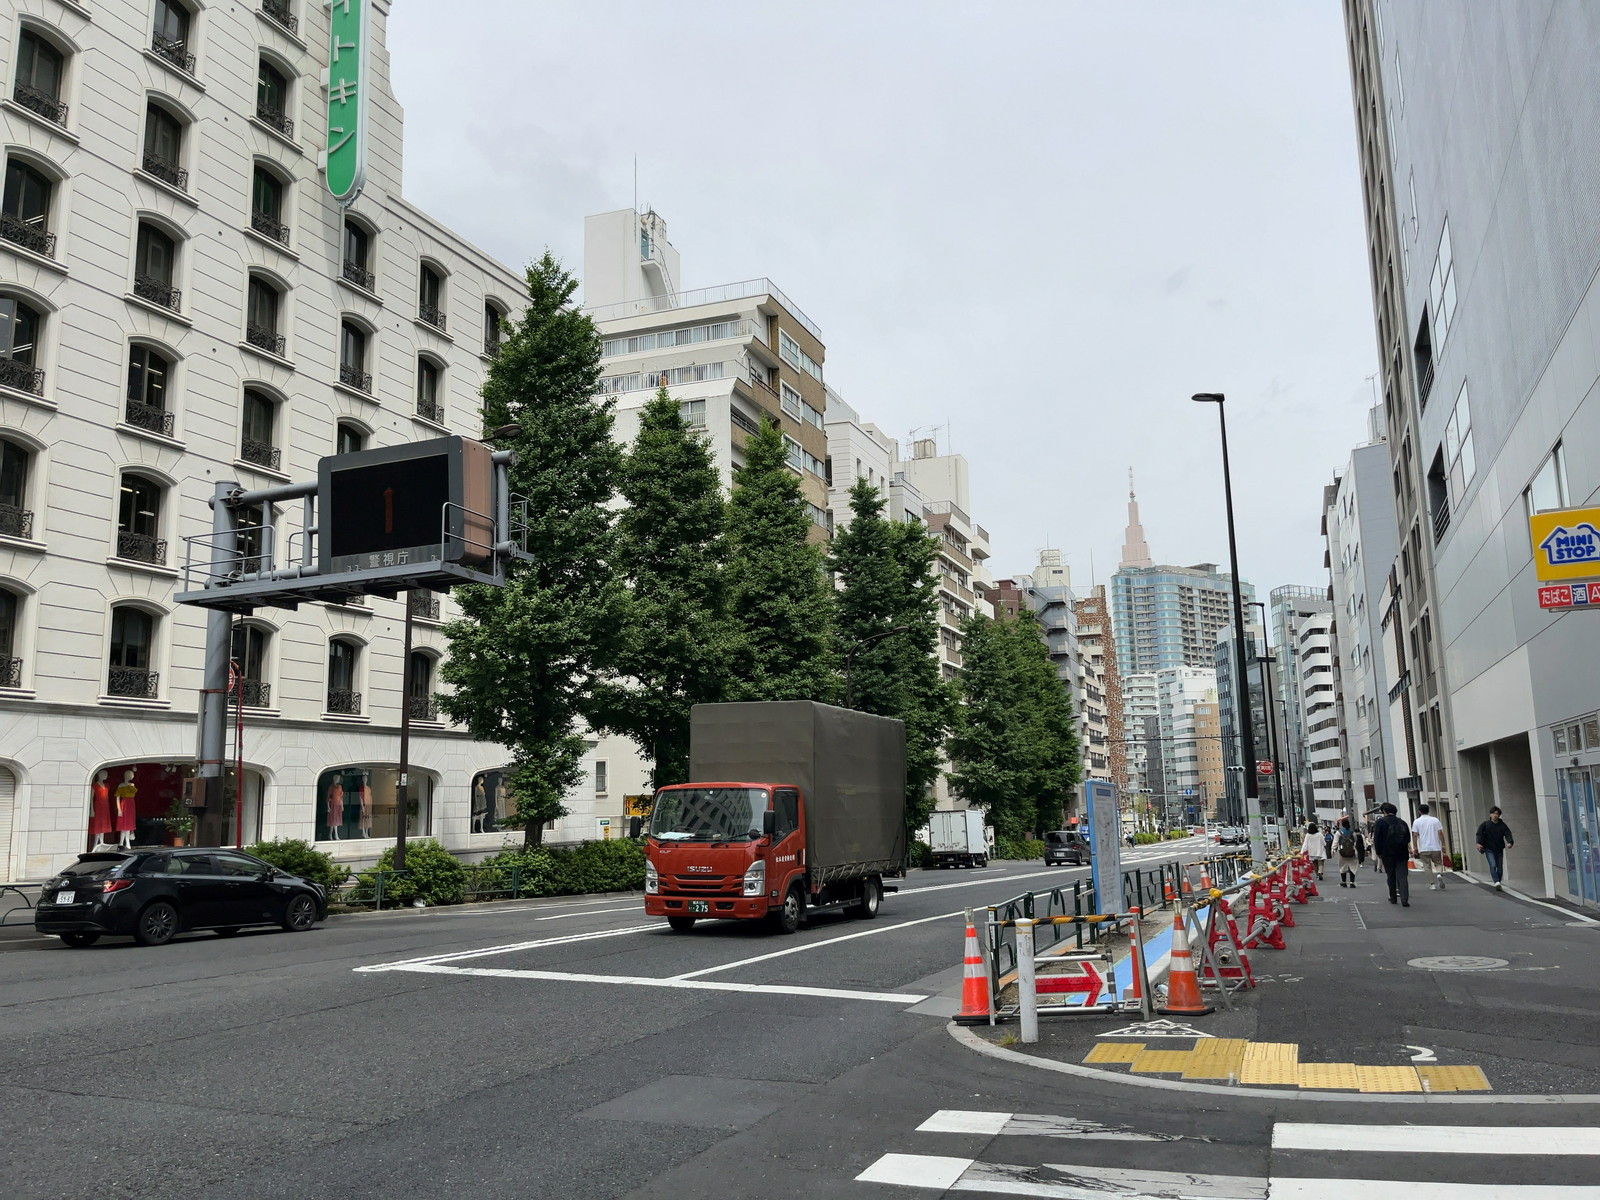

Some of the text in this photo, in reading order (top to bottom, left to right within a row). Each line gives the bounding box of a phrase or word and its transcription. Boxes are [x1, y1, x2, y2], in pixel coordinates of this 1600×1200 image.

[1556, 534, 1593, 547] MINI
[369, 551, 408, 568] 警視庁
[1556, 546, 1596, 560] STOP
[1541, 589, 1570, 604] たばこ
[1573, 587, 1586, 602] 酒
[687, 865, 713, 873] ISUZU
